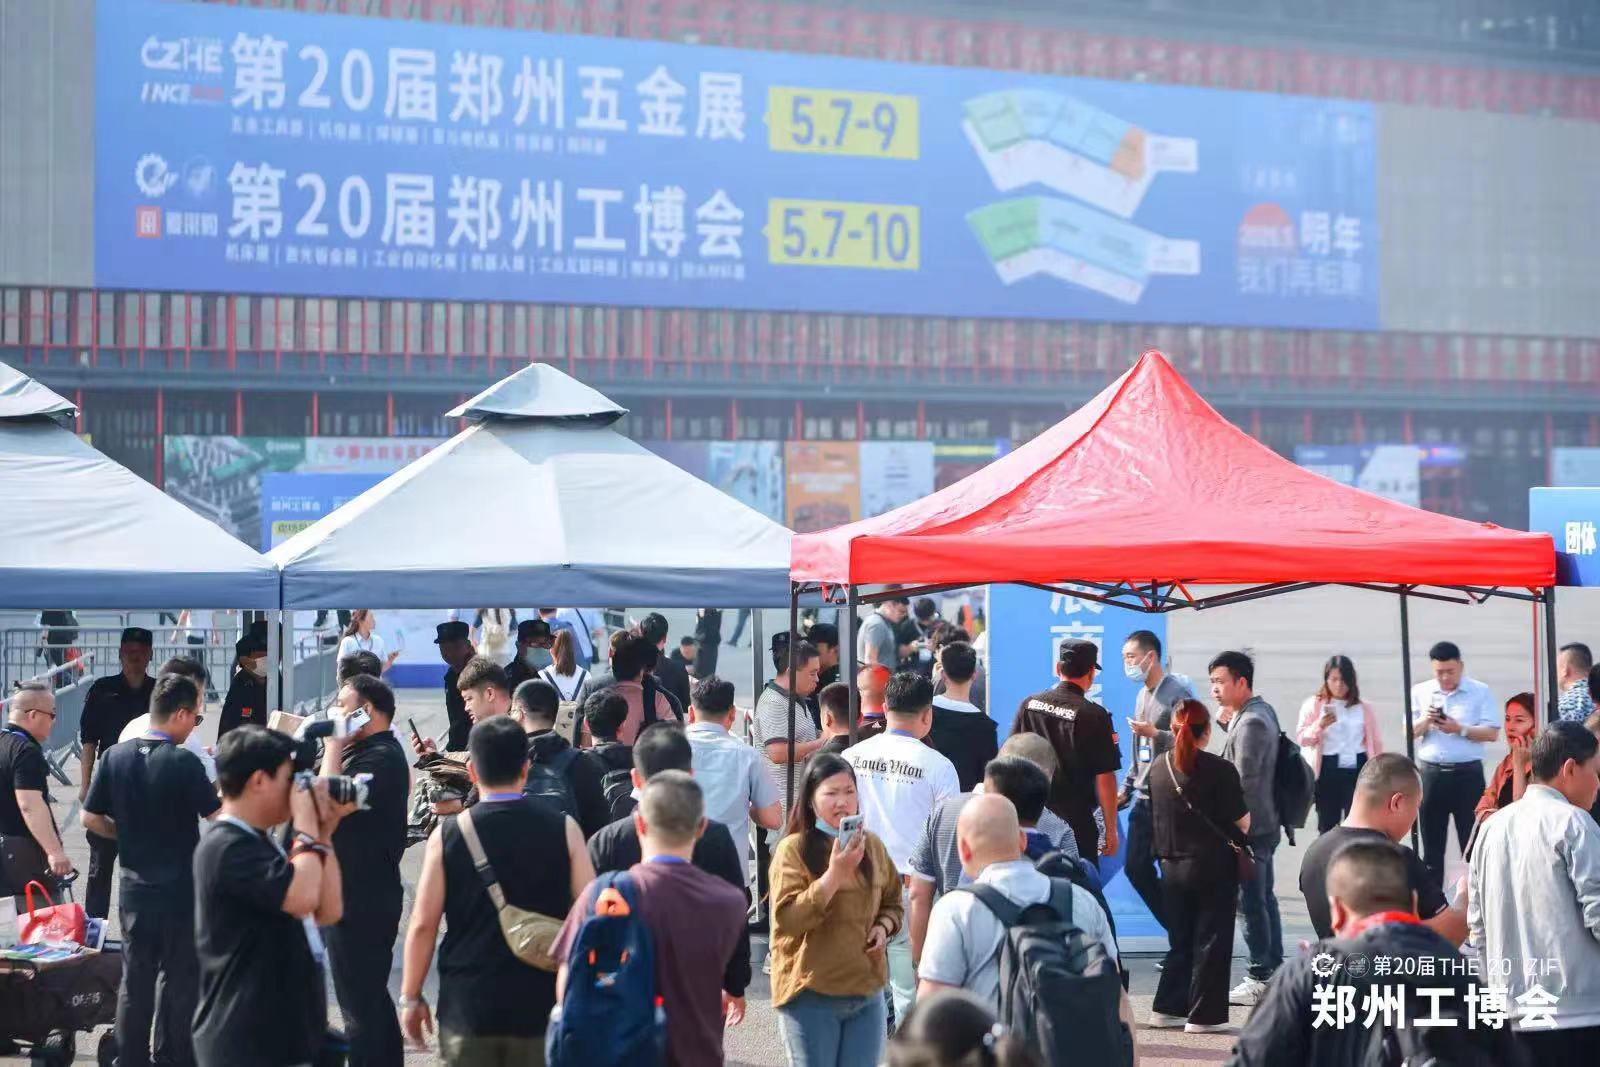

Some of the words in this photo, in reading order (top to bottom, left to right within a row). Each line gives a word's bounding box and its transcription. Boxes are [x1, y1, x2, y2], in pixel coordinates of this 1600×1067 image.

[230, 32, 746, 141] 第20届郑州五金展
[789, 96, 898, 151] 5.7-9
[227, 160, 744, 259] 第20届郑州工博会
[783, 208, 911, 263] 5.7-10
[1565, 521, 1597, 555] 团体
[852, 756, 887, 772] Louis
